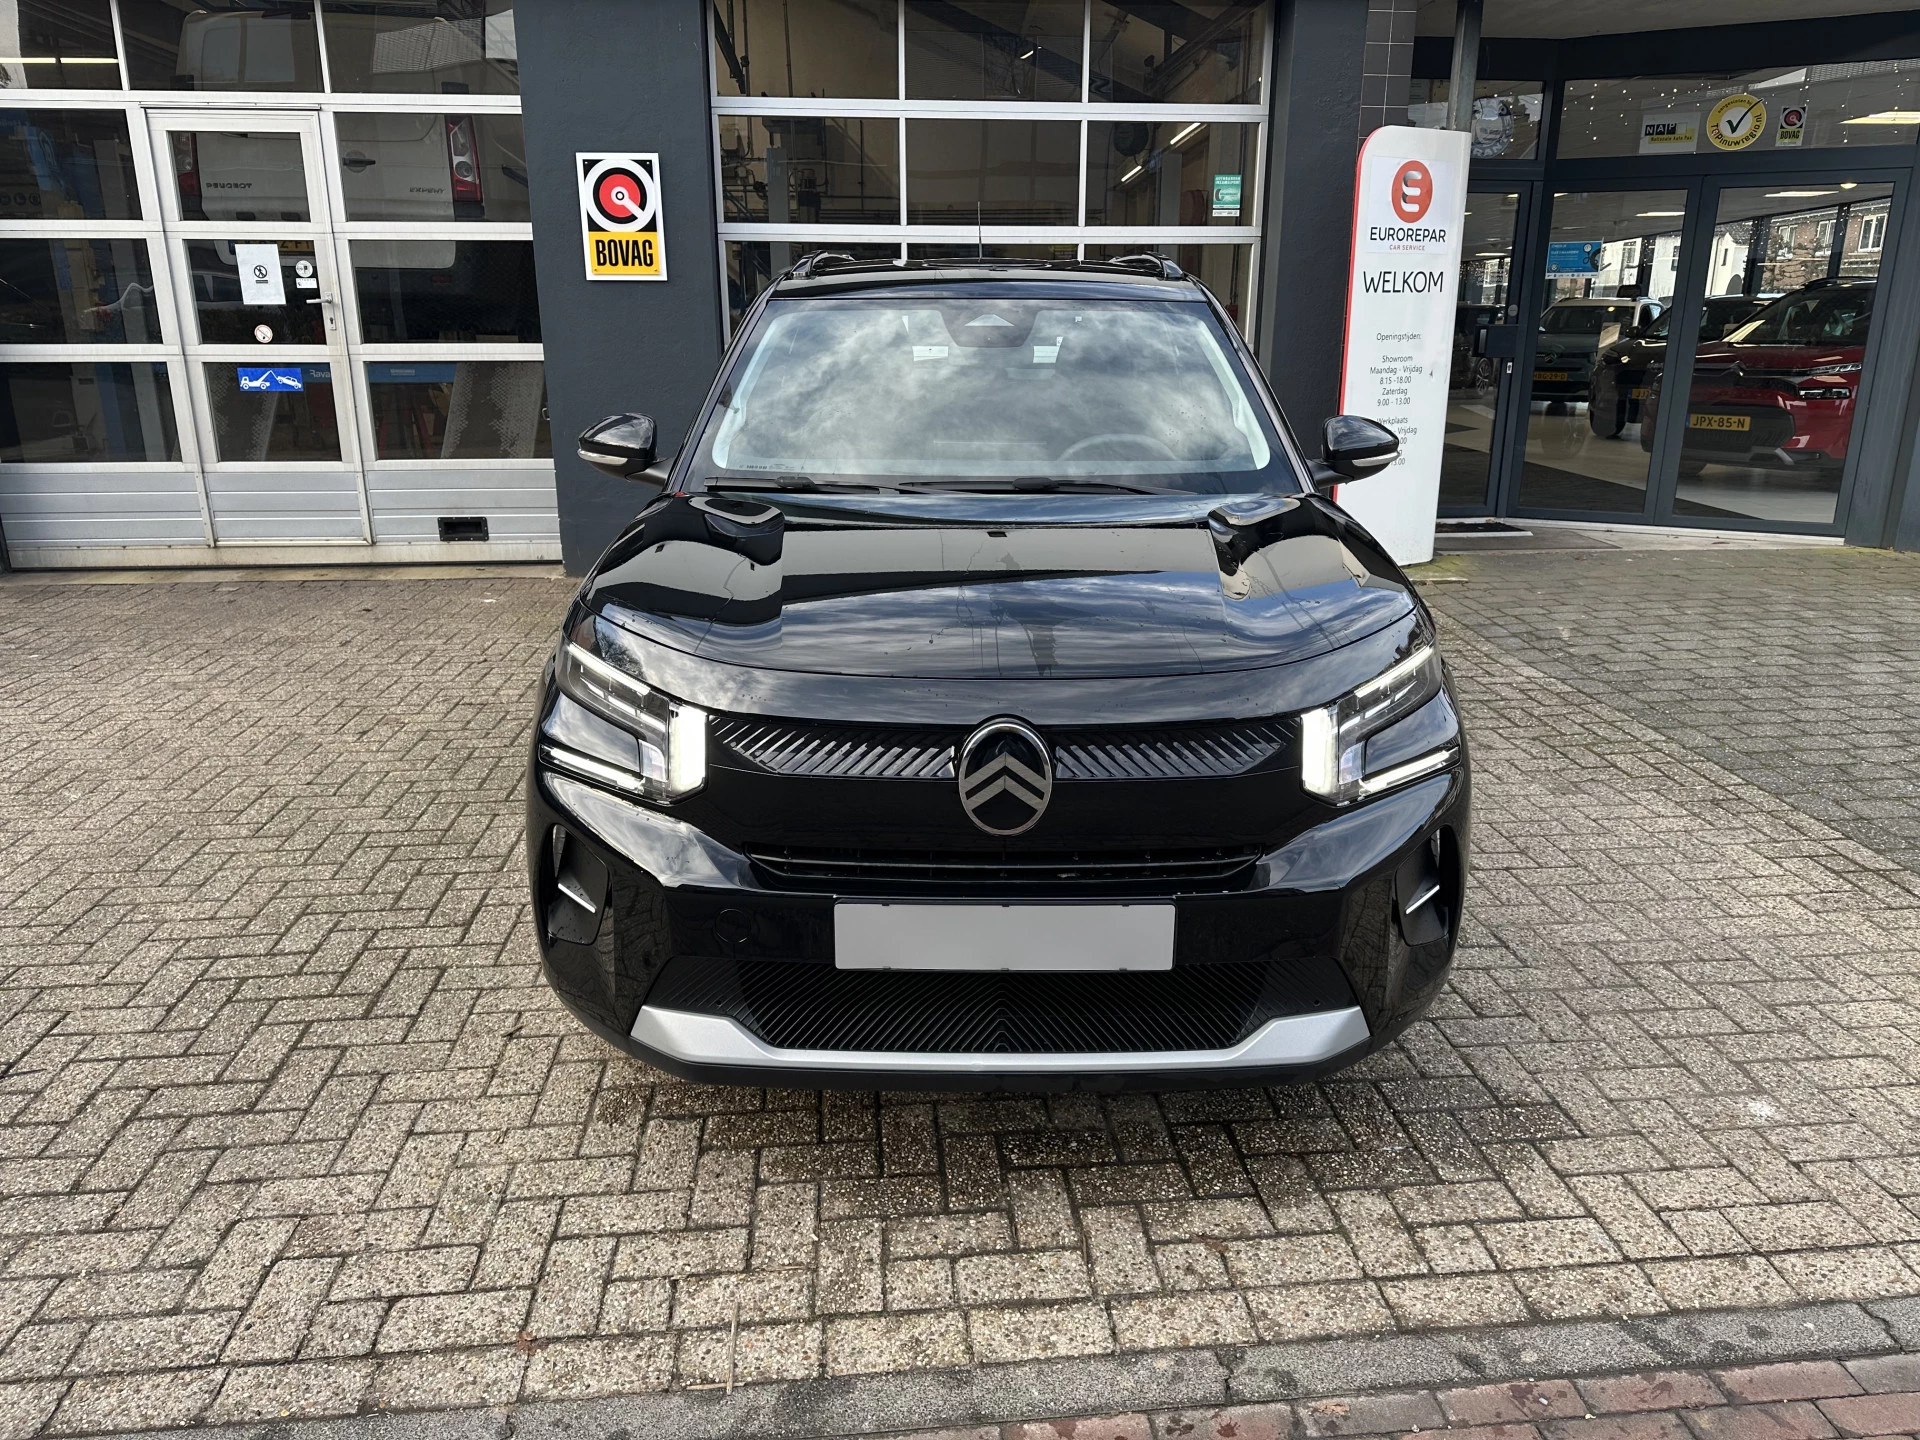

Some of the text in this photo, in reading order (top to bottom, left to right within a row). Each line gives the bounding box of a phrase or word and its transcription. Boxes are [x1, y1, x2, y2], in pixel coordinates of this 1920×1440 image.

[1645, 123, 1676, 135] NAP
[1780, 130, 1800, 139] BOVAG
[1370, 227, 1446, 242] EUROREPAR
[595, 239, 654, 267] BOVAG
[1363, 271, 1443, 293] WELKOM
[1382, 355, 1413, 363] Showroom
[1370, 366, 1397, 375] Maandag
[1403, 365, 1422, 374] Vrijdag
[1382, 387, 1407, 396] Zaterdag
[1377, 398, 1389, 406] 9.00
[1395, 397, 1410, 405] 13.00
[1693, 415, 1745, 428] JPX-85-N
[1398, 426, 1417, 435] Vrijdag
